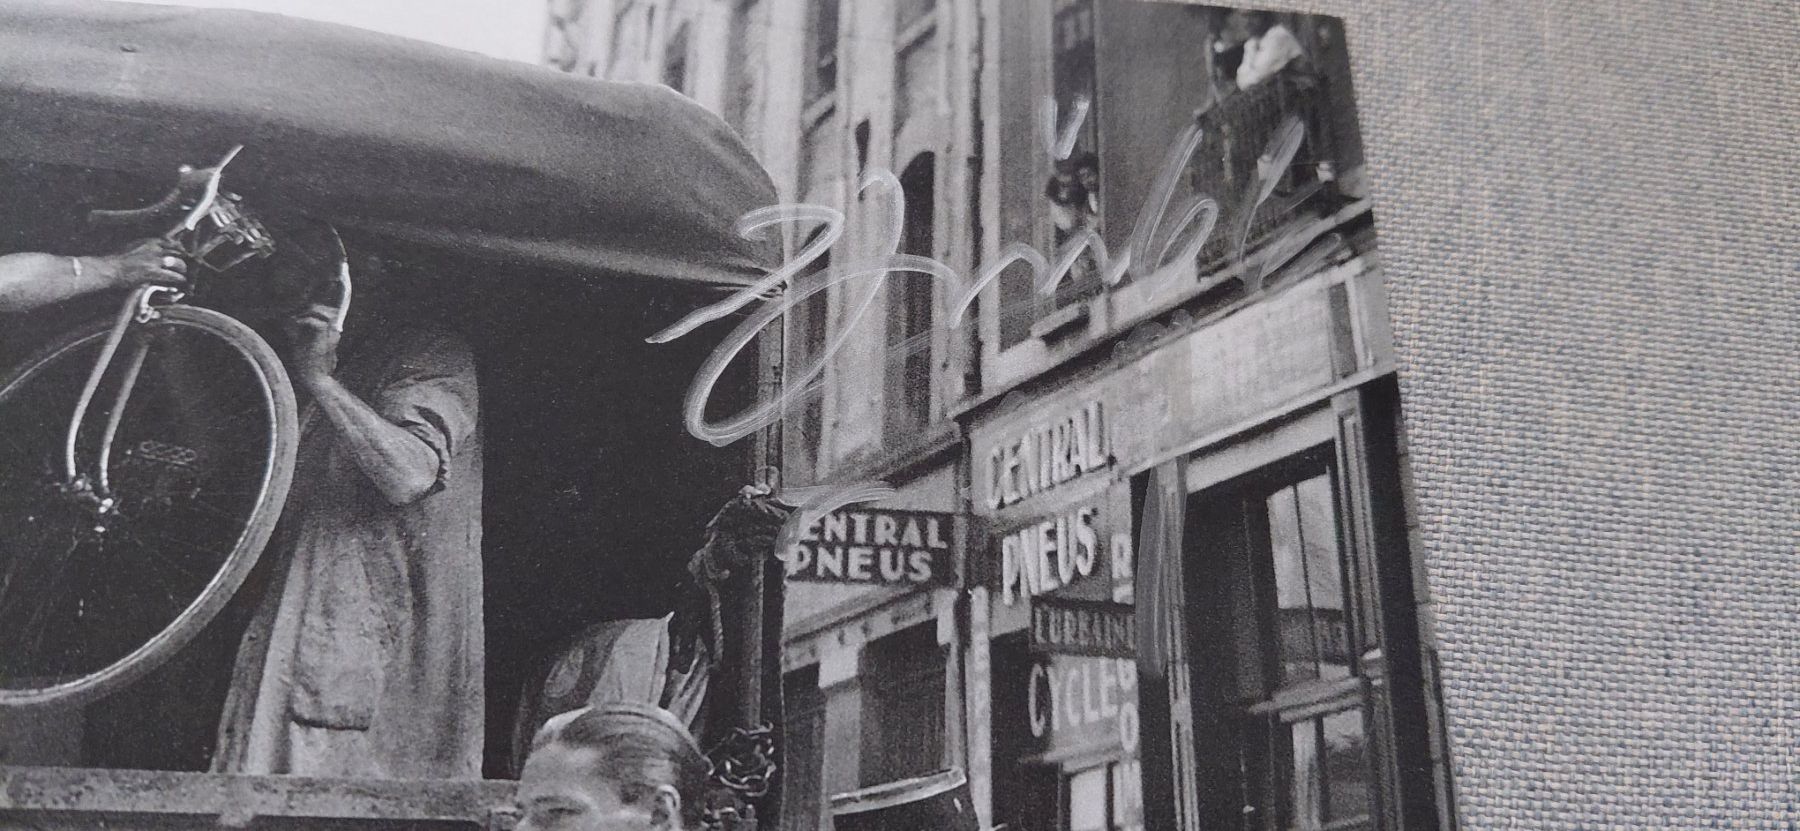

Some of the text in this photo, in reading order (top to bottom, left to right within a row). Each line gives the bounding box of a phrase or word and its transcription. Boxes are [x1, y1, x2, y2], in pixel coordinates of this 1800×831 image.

[984, 399, 1109, 510] CENTRAL
[783, 543, 934, 582] PNEUS
[788, 511, 949, 549] ENTRAL
[1002, 505, 1096, 605] PNEUS
